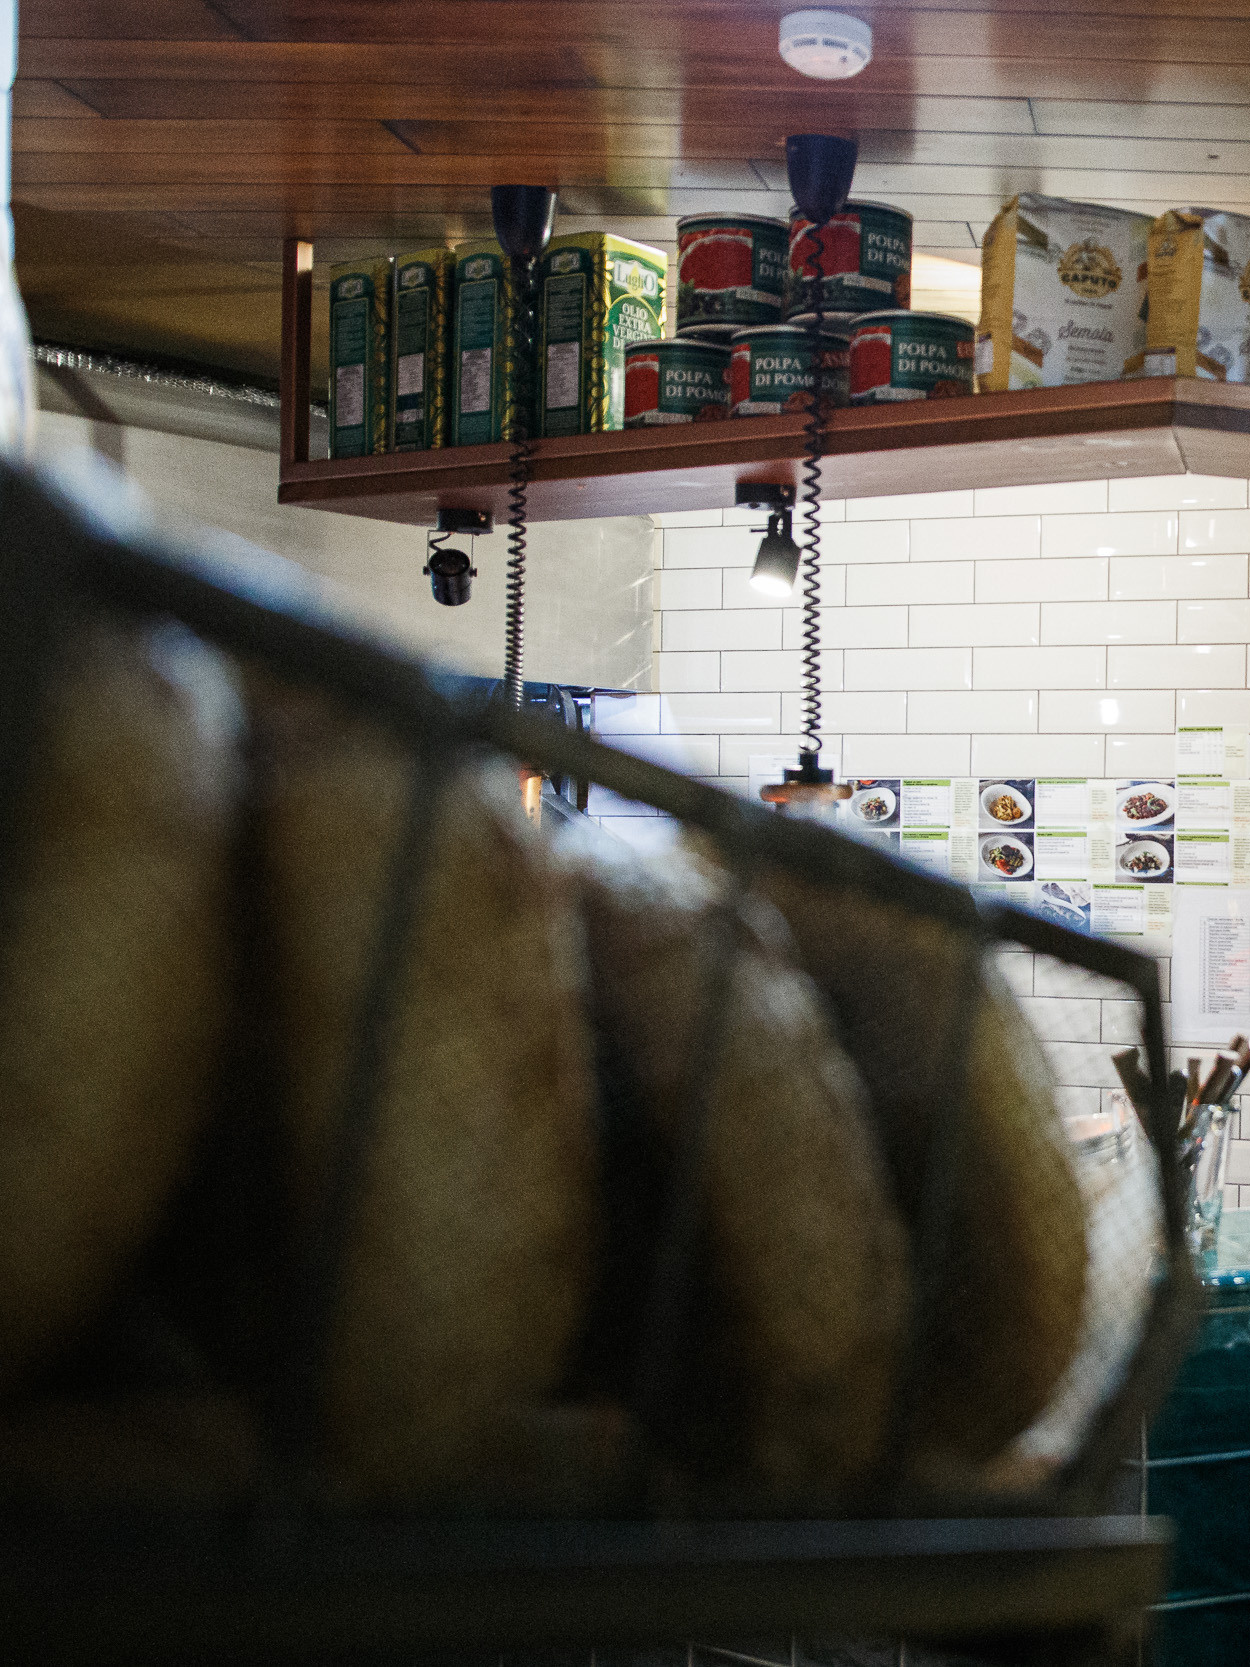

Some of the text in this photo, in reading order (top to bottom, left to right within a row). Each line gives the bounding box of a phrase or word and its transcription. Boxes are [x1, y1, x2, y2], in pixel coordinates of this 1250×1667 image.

[622, 302, 649, 319] OLIO
[619, 313, 652, 334] EXTRA
[898, 342, 947, 358] POLPA
[754, 357, 802, 371] POLPA
[898, 358, 917, 372] DI
[665, 368, 713, 385] POLPA
[754, 372, 771, 386] DI
[665, 384, 683, 397] DI
